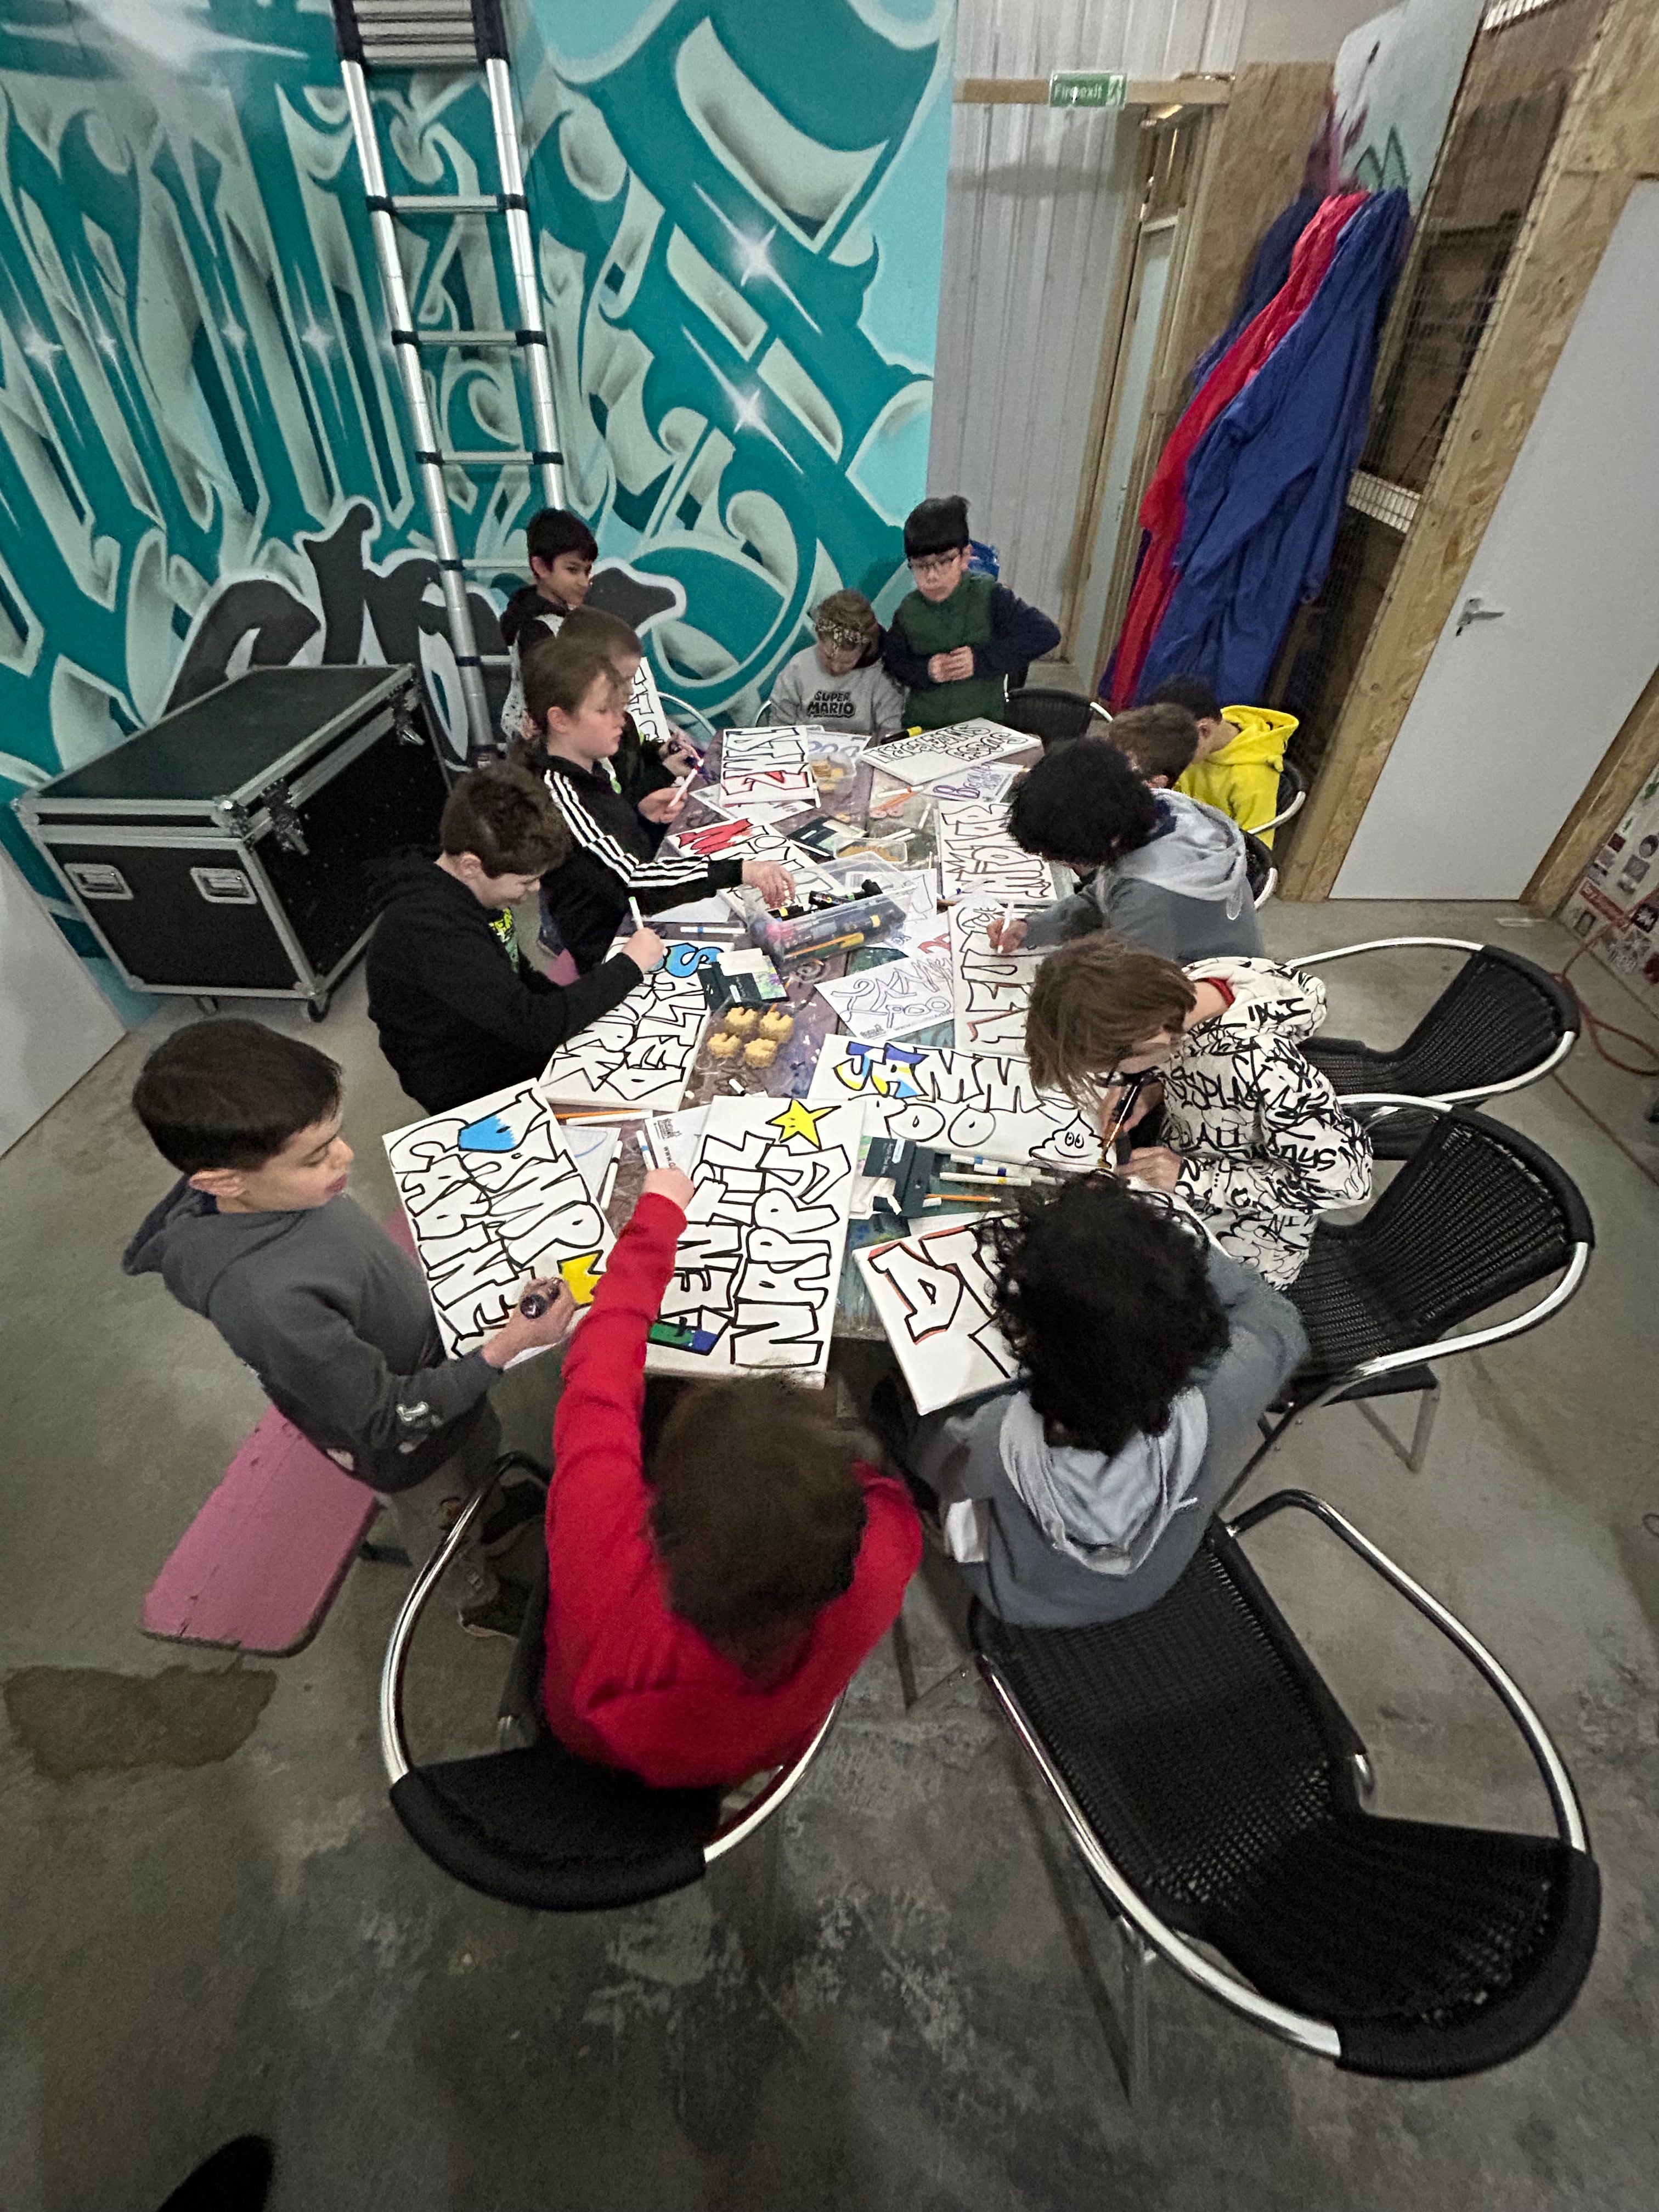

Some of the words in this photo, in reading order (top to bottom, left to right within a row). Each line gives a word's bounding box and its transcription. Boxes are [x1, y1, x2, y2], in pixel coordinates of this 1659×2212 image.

[806, 701, 856, 718] MARIO
[814, 690, 851, 702] SUPER
[458, 1087, 604, 1268] DAMP
[730, 1143, 852, 1367] NAPPY
